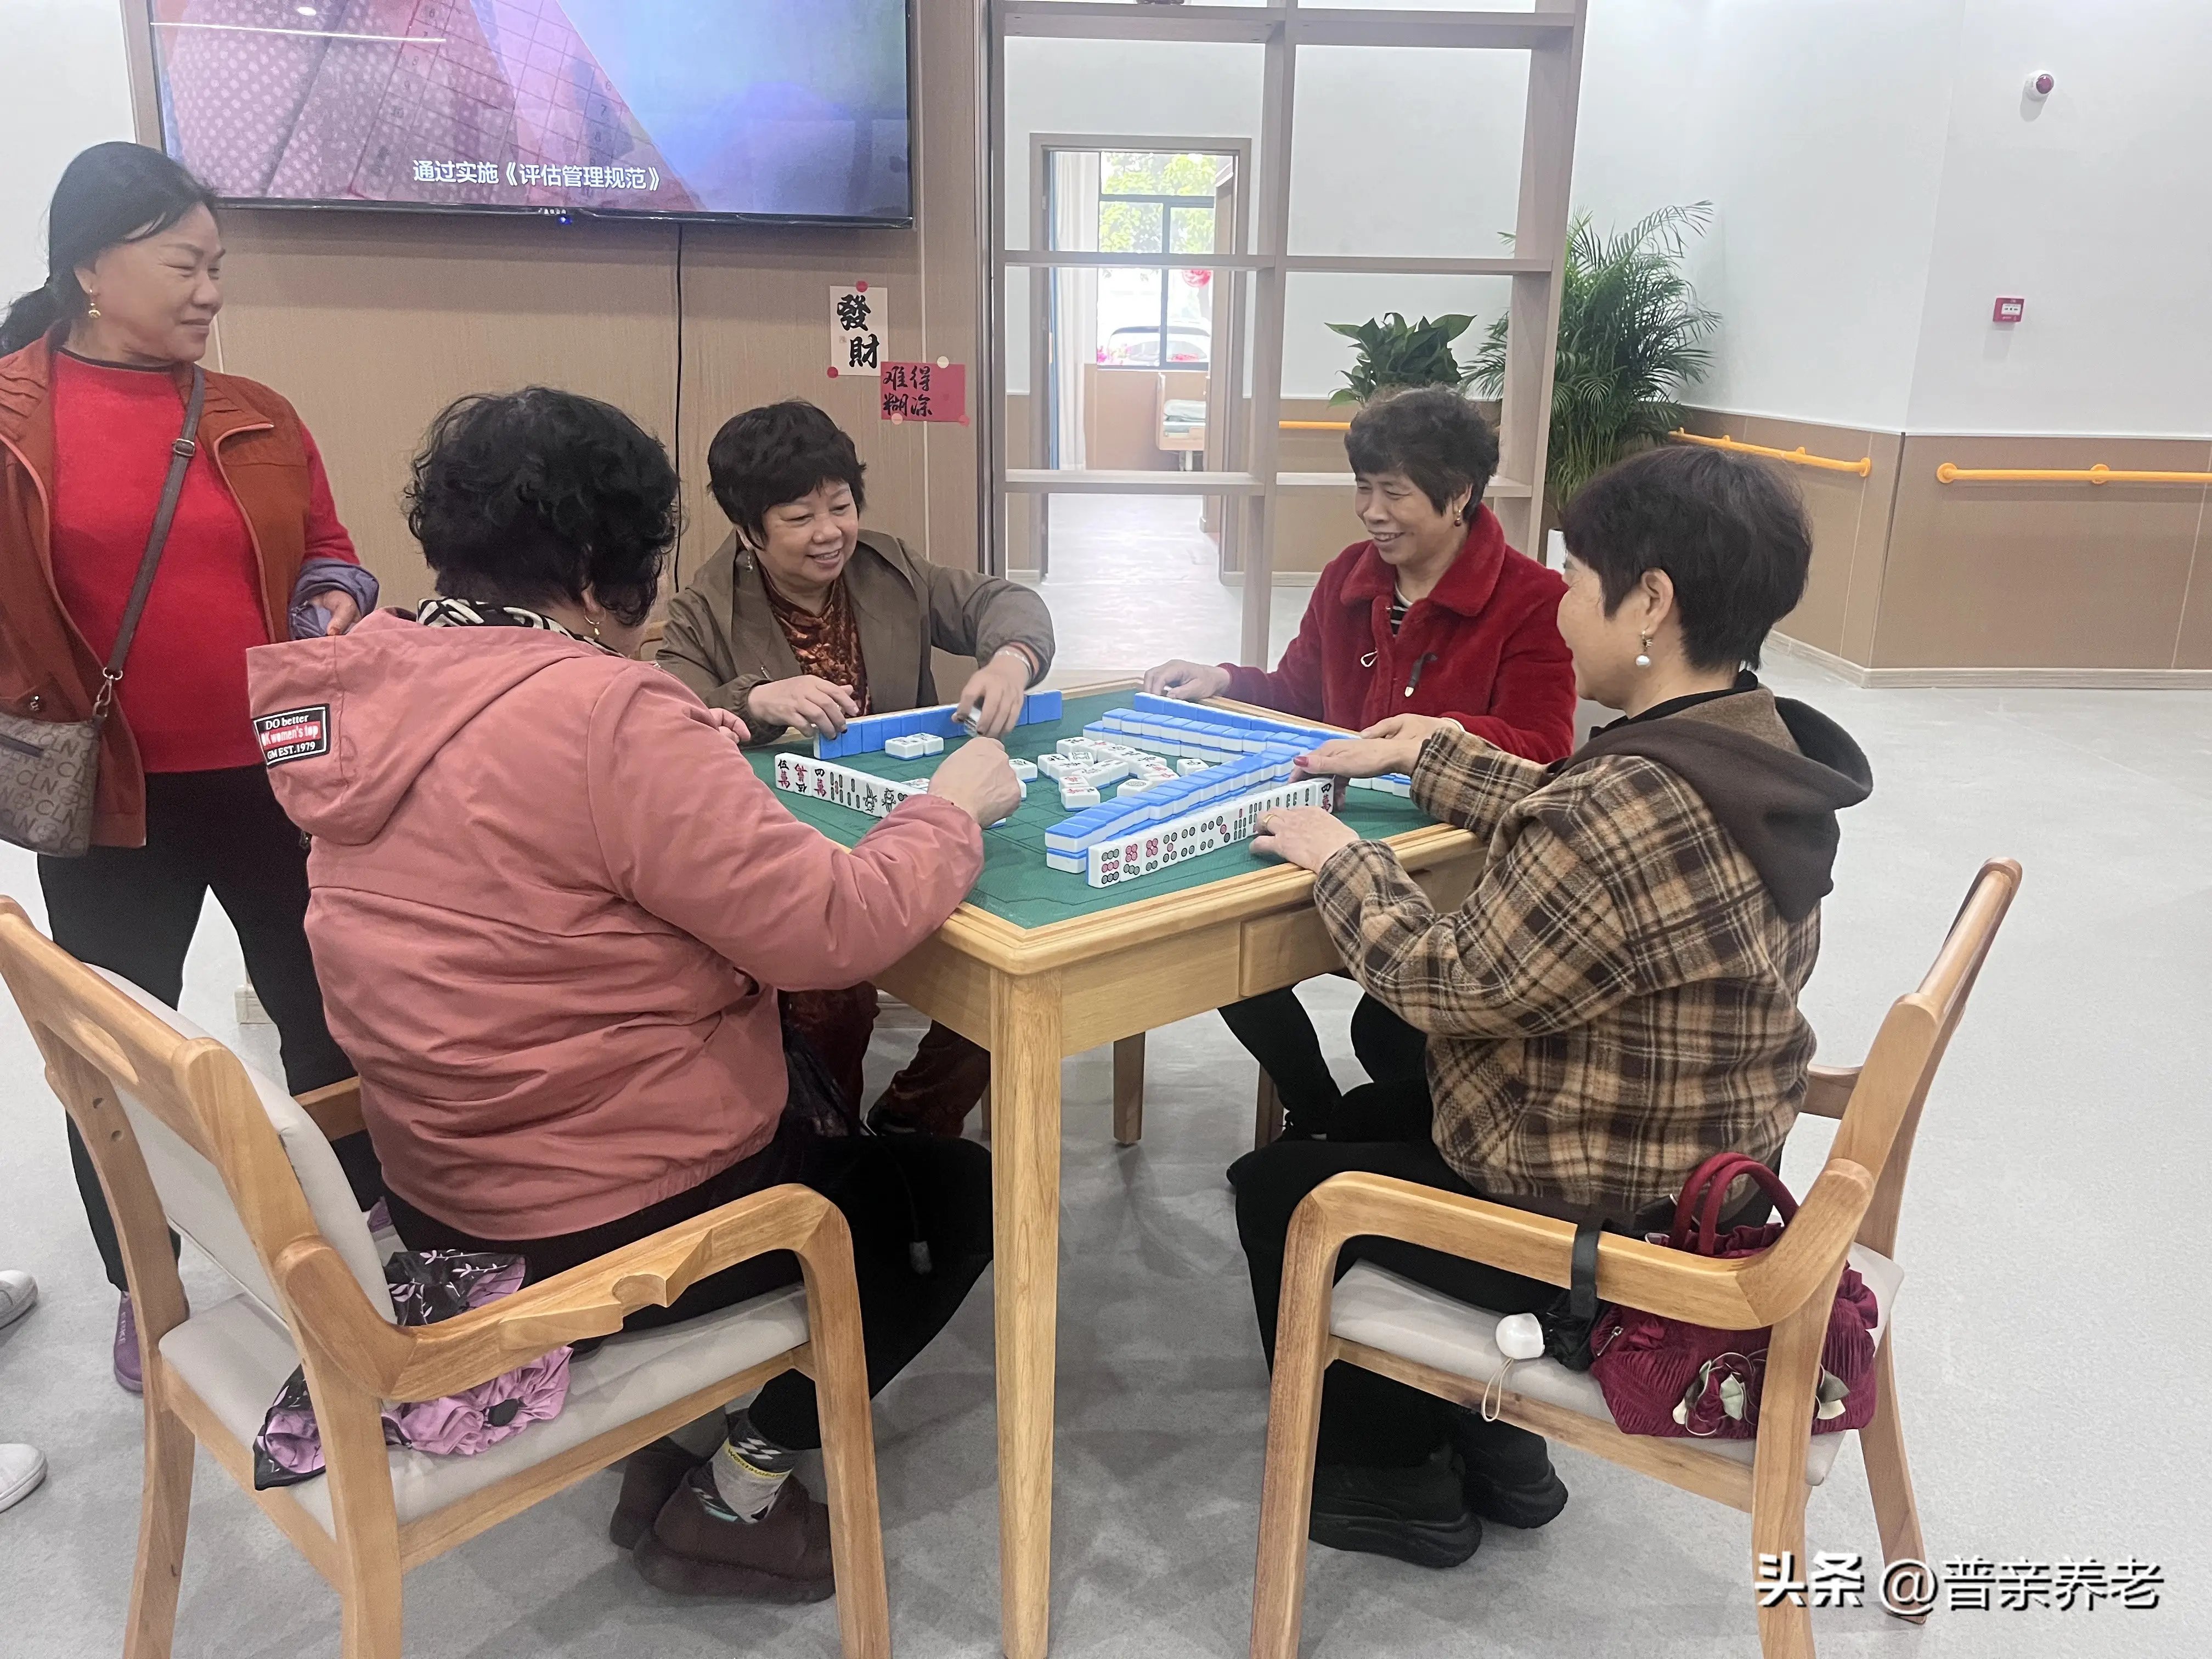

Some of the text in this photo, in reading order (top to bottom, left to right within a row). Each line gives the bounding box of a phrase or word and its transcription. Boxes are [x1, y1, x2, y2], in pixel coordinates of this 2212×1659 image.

[413, 160, 660, 191] 通过实施《评估管理规范》
[837, 294, 879, 369] 發財
[883, 365, 930, 391] 难得
[265, 715, 309, 730] DO better
[304, 725, 319, 738] top
